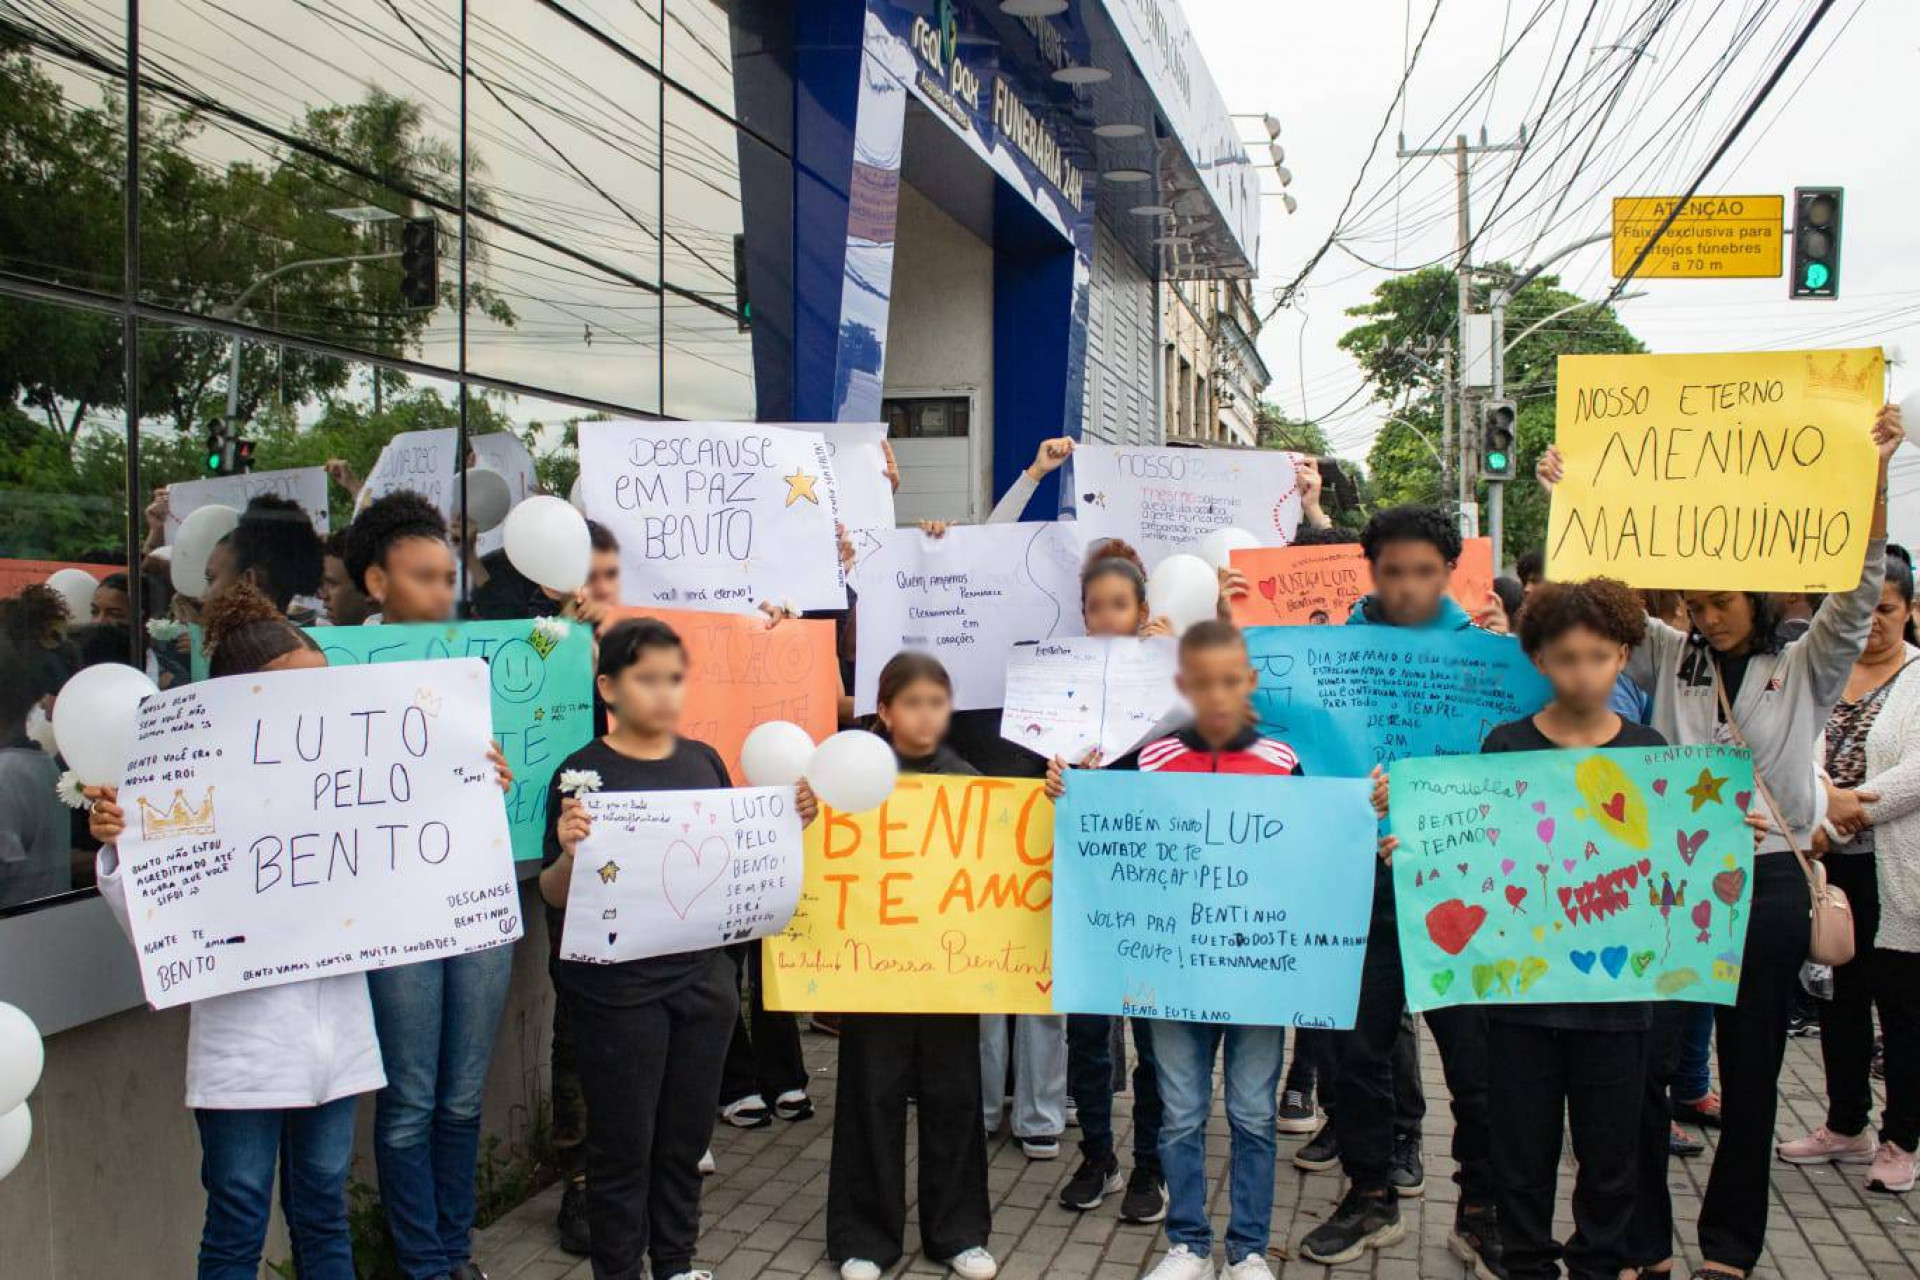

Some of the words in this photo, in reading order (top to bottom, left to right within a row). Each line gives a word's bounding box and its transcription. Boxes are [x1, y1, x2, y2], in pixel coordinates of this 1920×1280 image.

[953, 58, 979, 110] pax
[994, 77, 1062, 192] FUNERÁRIA
[1623, 227, 1659, 238] Faix
[1667, 227, 1733, 238] exclusiva
[1740, 228, 1771, 240] para
[1634, 244, 1693, 258] crtejos
[1697, 242, 1761, 254] fúnebres
[1672, 262, 1679, 270] a
[1687, 259, 1704, 270] 70
[1710, 261, 1722, 270] m
[1575, 385, 1650, 425] NOSSO
[1679, 380, 1784, 416] ETERNO
[686, 470, 757, 504] PAZ
[1307, 648, 1331, 666] DIA
[253, 706, 428, 765] LUTO
[314, 763, 411, 811] PELO
[730, 794, 784, 823] LUTO
[824, 779, 1053, 866] BENTO
[1418, 808, 1478, 831] BENTO
[735, 829, 777, 850] PELO
[1205, 808, 1284, 846] LUTO
[132, 857, 161, 875] BENTO
[249, 822, 451, 893] BENTO
[938, 868, 1052, 915] AMO
[1199, 864, 1249, 890] PELO
[447, 883, 512, 908] DESCANSE
[824, 872, 919, 930] TE
[1147, 914, 1177, 934] PRA
[157, 955, 215, 992] BENTO
